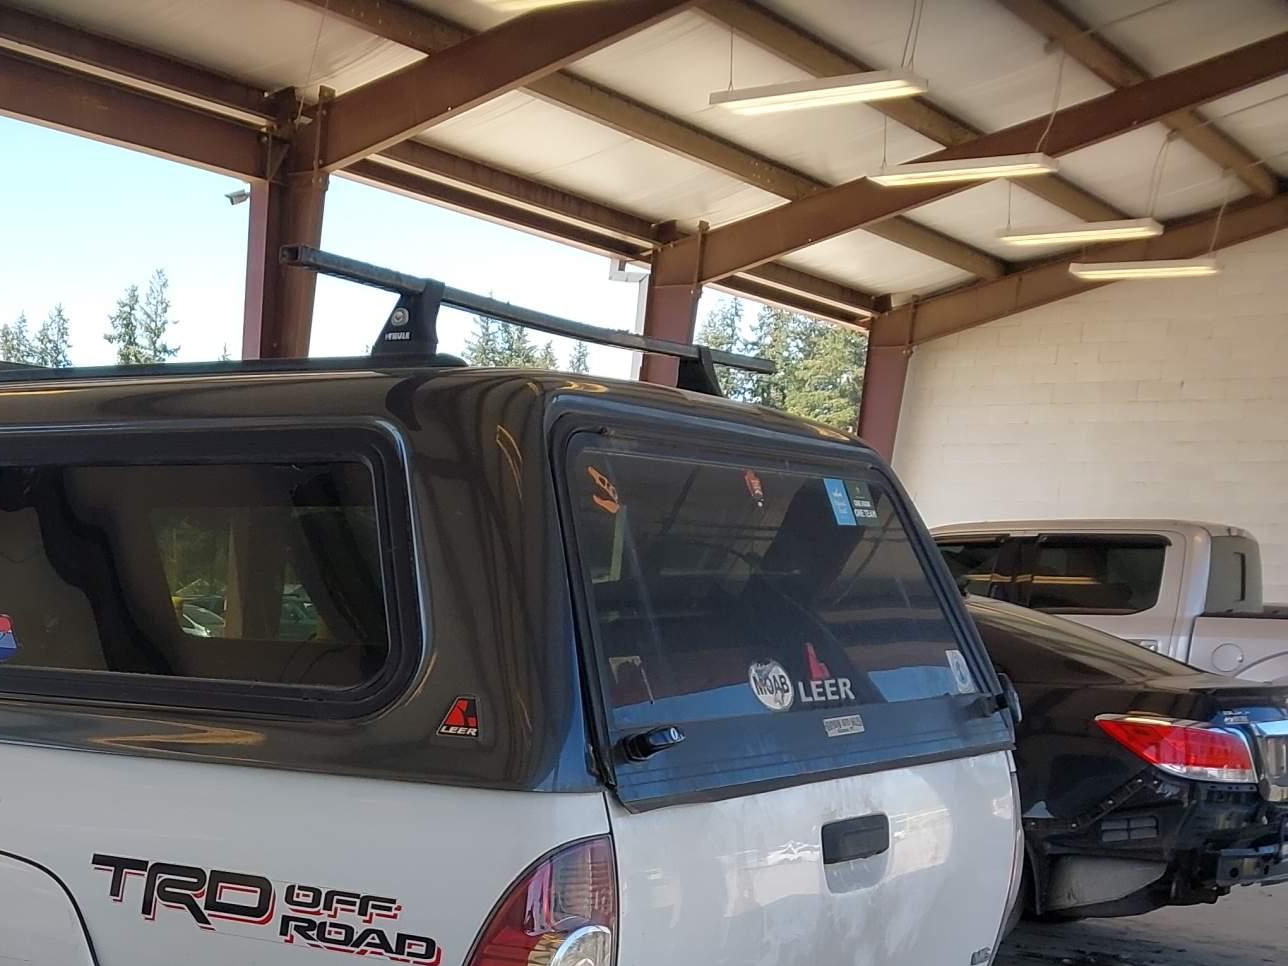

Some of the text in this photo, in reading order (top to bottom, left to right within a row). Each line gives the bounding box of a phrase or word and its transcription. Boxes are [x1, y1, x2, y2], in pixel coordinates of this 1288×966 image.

[753, 674, 789, 696] MOAB
[798, 678, 855, 702] LEER
[439, 725, 478, 736] LEER
[92, 853, 402, 931] TRD OFF
[279, 914, 442, 966] ROAD
